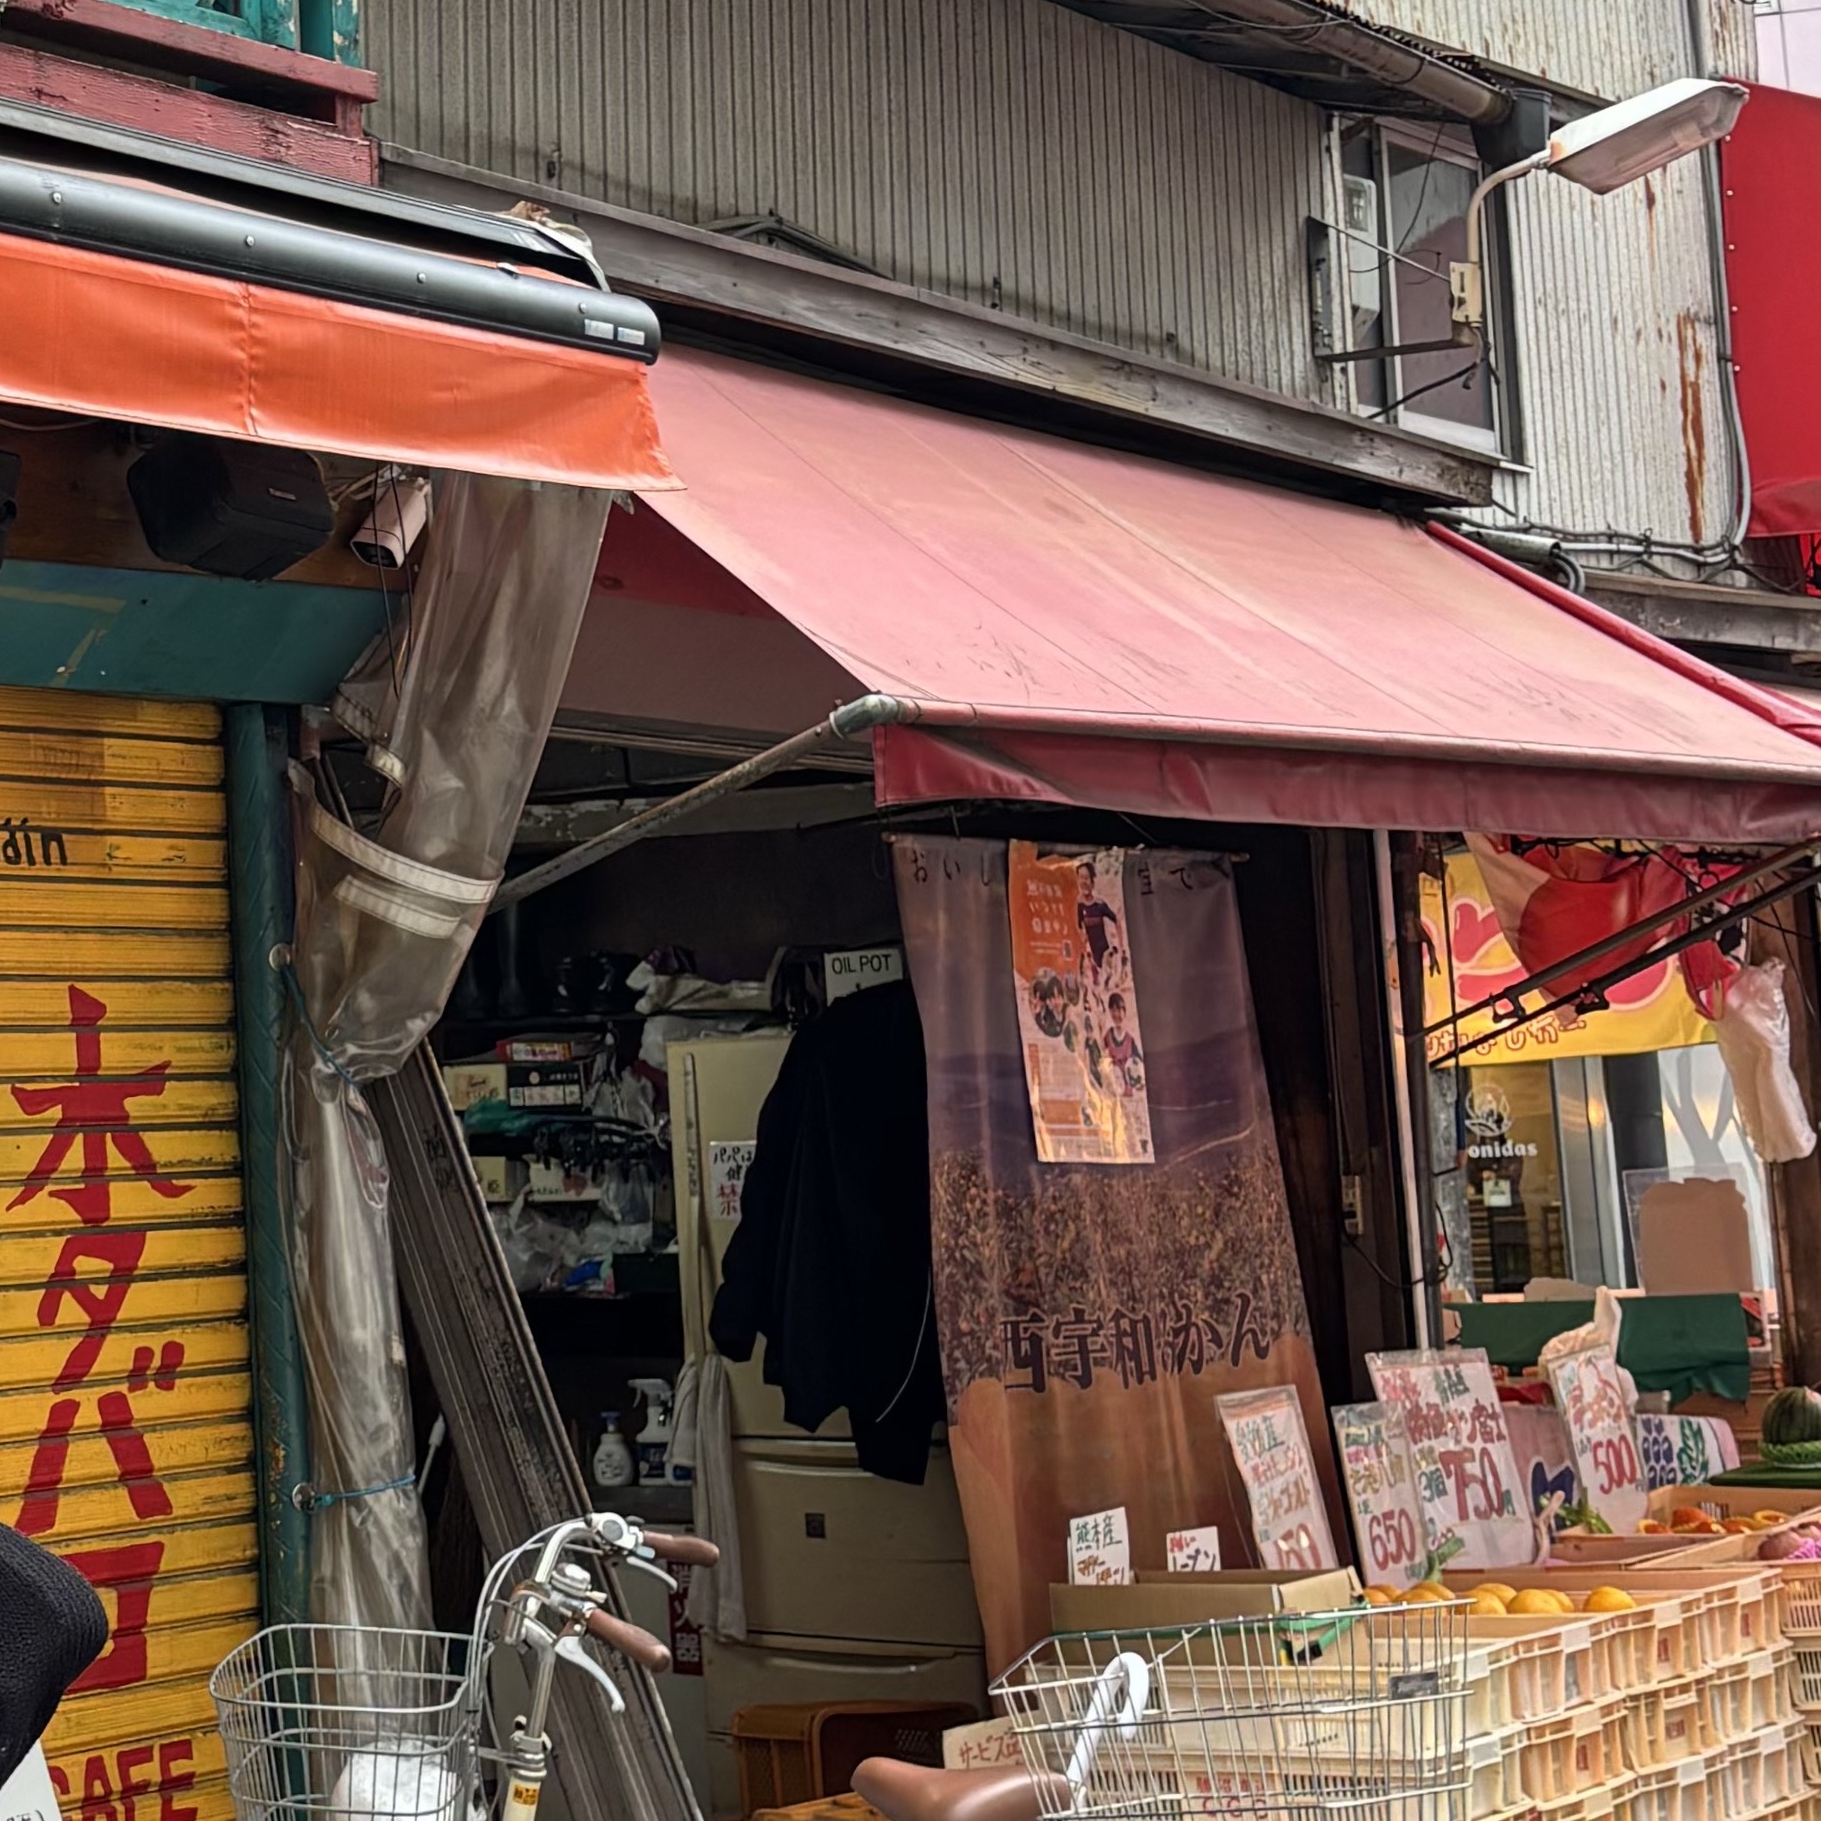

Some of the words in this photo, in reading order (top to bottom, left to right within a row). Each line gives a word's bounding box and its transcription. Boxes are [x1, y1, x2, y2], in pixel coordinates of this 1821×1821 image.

[831, 955, 860, 975] OIL
[862, 953, 894, 974] POT
[1438, 1446, 1505, 1522] 750
[1591, 1433, 1639, 1495] 500
[1368, 1507, 1416, 1571] 650
